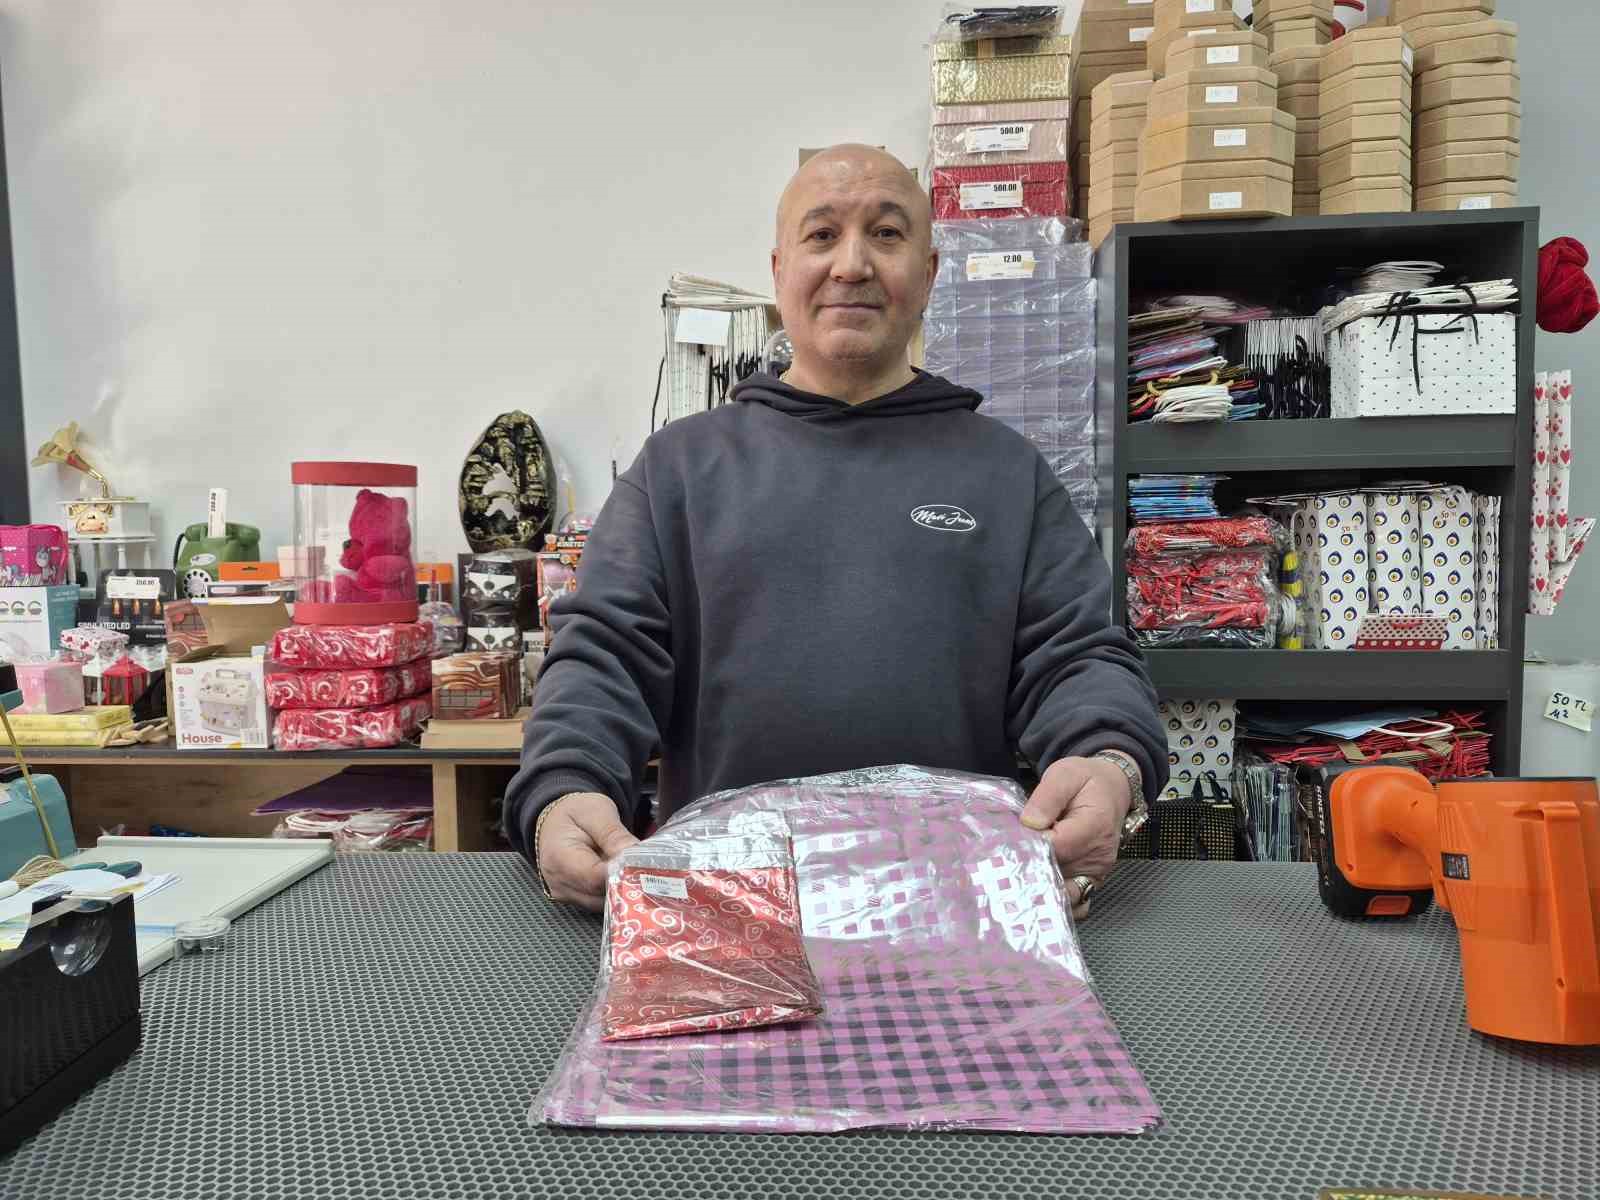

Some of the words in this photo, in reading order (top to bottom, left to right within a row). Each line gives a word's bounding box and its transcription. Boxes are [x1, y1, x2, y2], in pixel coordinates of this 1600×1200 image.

[1000, 126, 1024, 135] 500.00
[993, 183, 1017, 192] 500.00
[1003, 254, 1022, 263] 12.00
[1552, 692, 1570, 706] 50
[1575, 699, 1587, 711] TL
[182, 733, 223, 744] House
